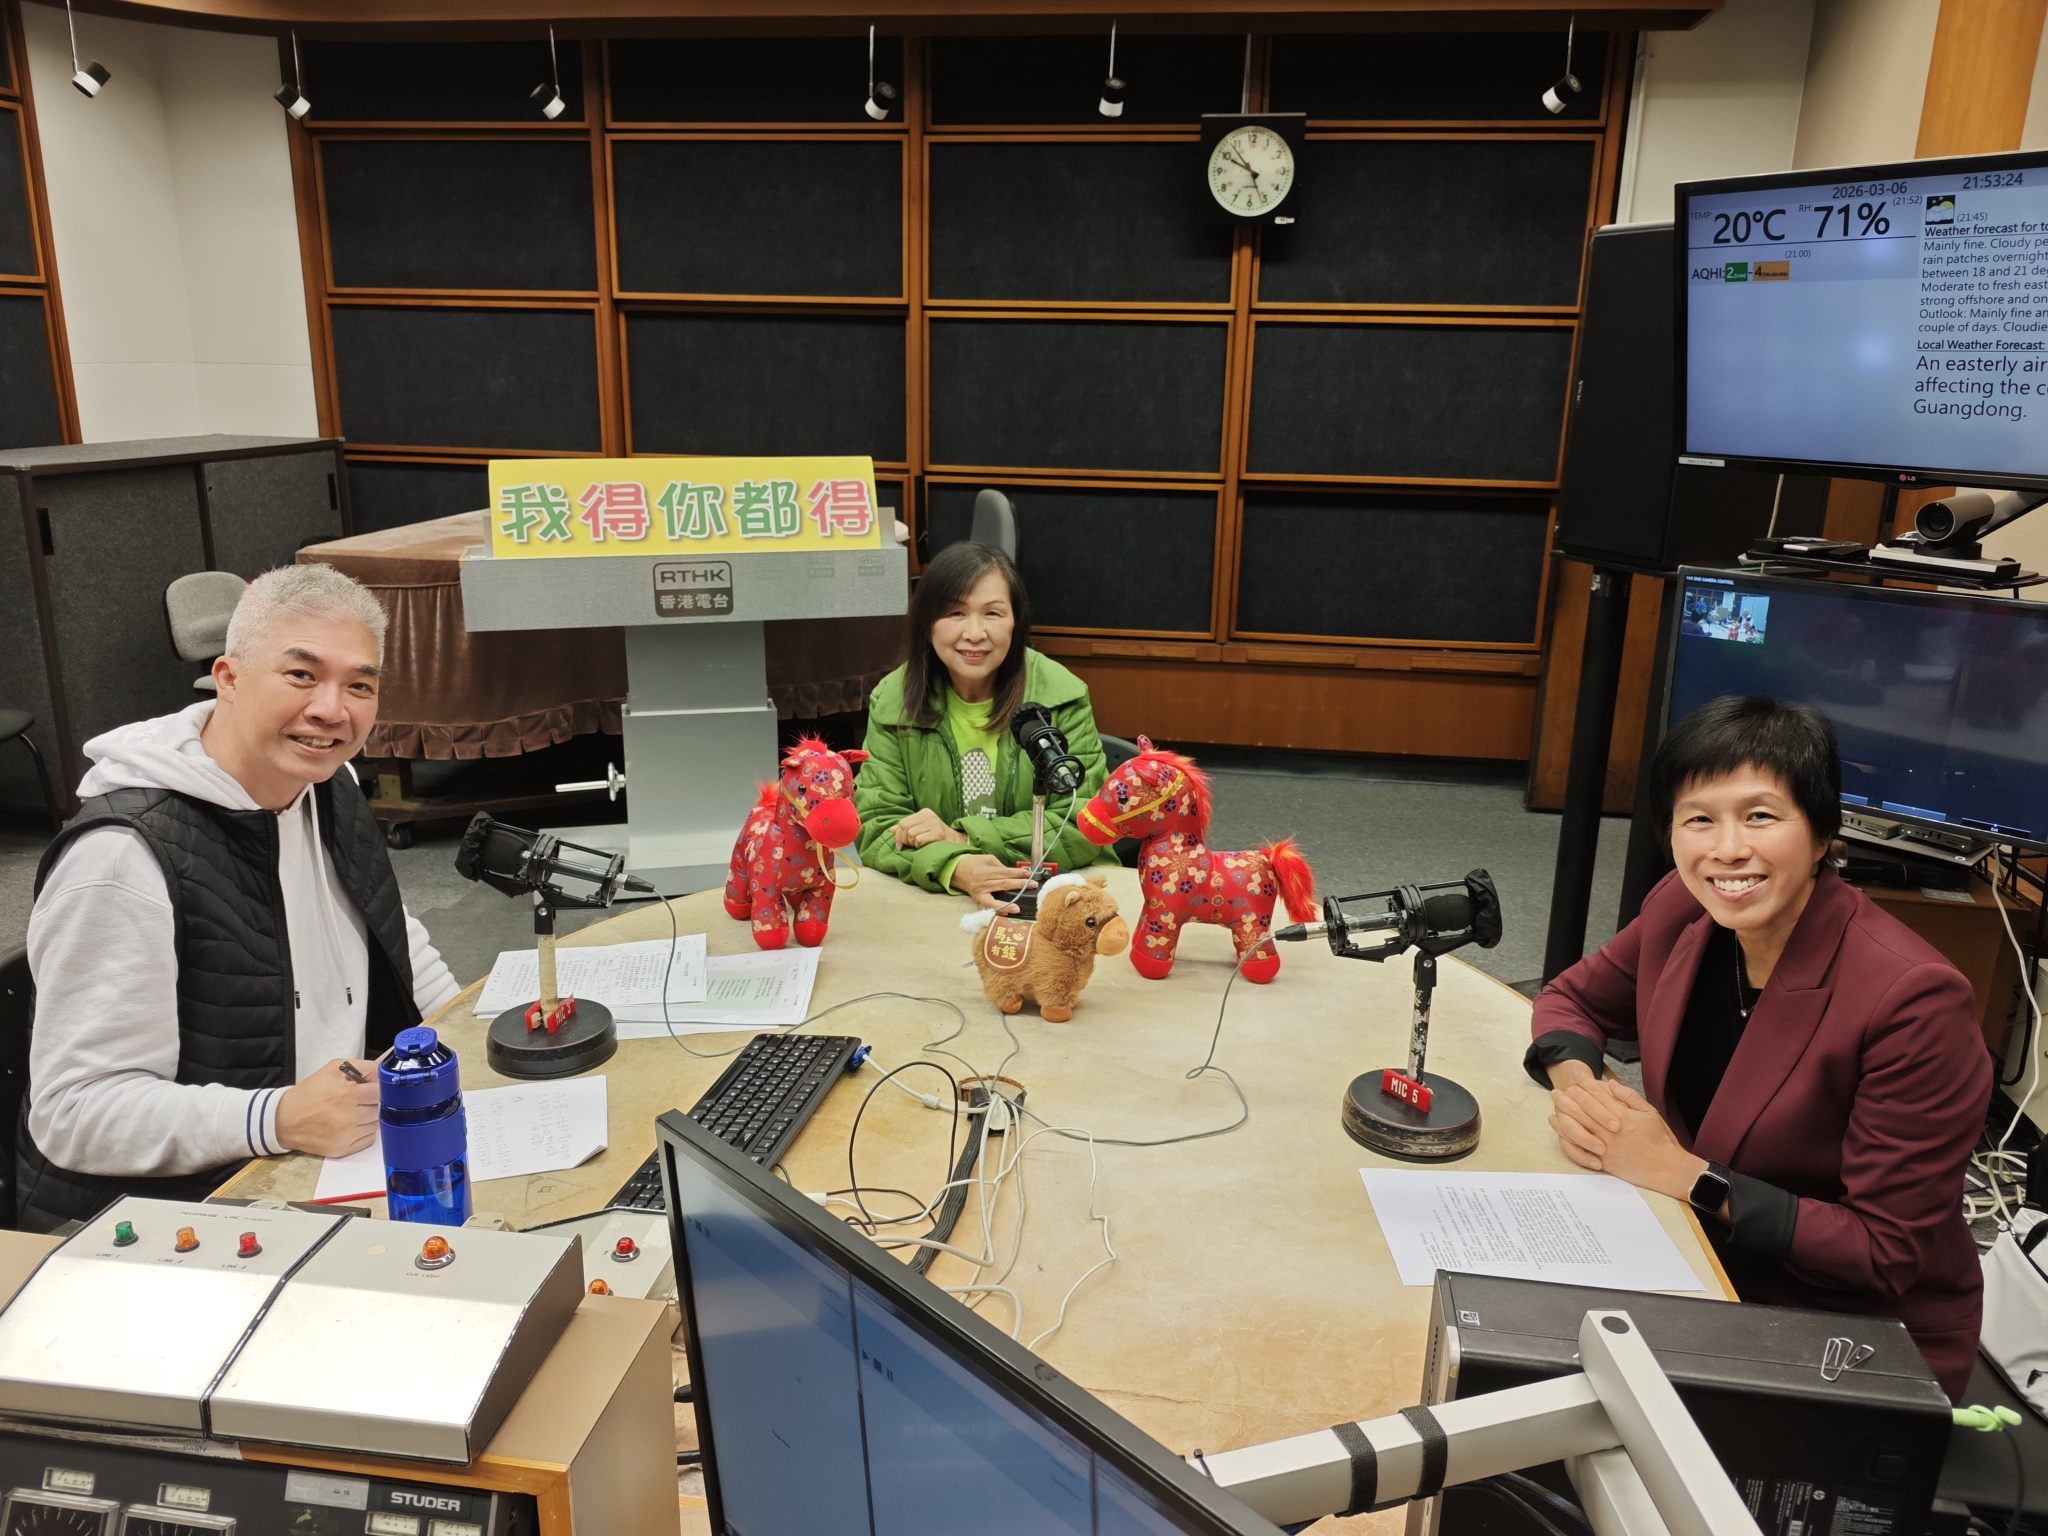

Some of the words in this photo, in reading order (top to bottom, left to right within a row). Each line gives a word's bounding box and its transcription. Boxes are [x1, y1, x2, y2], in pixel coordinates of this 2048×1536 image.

[1217, 167, 1223, 176] 9
[1280, 167, 1286, 176] 3
[1221, 184, 1227, 192] 8
[1832, 181, 1908, 199] 2026-03-06
[1962, 172, 2024, 190] 21:53:24
[1232, 194, 1238, 203] 7
[1814, 201, 1890, 238] 71%
[1892, 195, 1923, 207] (21:52)
[1957, 212, 1988, 223] (21:45)
[1925, 225, 1971, 237] Weather
[1973, 223, 2018, 234] forecast
[2021, 221, 2038, 232] for
[1924, 240, 1960, 252] Mainly
[1963, 239, 1987, 250] fine.
[1990, 237, 2031, 250] Cloudy
[1923, 255, 1943, 265] rain
[1946, 253, 1990, 266] patches
[1992, 251, 2048, 264] overnight
[1691, 267, 1726, 280] AQHI:
[1754, 266, 1762, 278] 4
[1922, 268, 1969, 279] between
[1972, 266, 1986, 277] 18
[1989, 266, 2011, 277] and
[2013, 265, 2028, 276] 21
[2031, 265, 2048, 277] de
[1921, 281, 1975, 292] Moderate
[1978, 282, 1990, 291] to
[1993, 280, 2021, 291] fresh
[2024, 280, 2048, 290] east
[1920, 296, 1955, 307] strong
[1958, 295, 2005, 305] offshore
[2007, 293, 2030, 304] and
[2033, 296, 2048, 304] on
[1919, 308, 1966, 319] Outlook:
[1970, 308, 2008, 320] Mainly
[2010, 307, 2032, 318] fine
[1918, 322, 1955, 334] couple
[1957, 321, 1969, 332] of
[1971, 322, 2000, 334] days.
[2003, 321, 2048, 332] Cloudie
[1917, 340, 1945, 350] Local
[1947, 339, 1993, 350] Weather
[1996, 339, 2046, 350] Forecast:
[1916, 355, 1940, 371] An
[1946, 355, 2018, 377] easterly
[2023, 356, 2048, 372] air
[1914, 376, 1994, 399] affecting
[2000, 378, 2031, 395] the
[2036, 383, 2048, 396] c
[1913, 399, 2027, 422] Guangdong.
[499, 479, 874, 543] 我得你都得
[660, 568, 726, 583] RTHK
[660, 593, 729, 610] 香港電台
[1391, 1077, 1408, 1098] MIC
[391, 1491, 461, 1512] STUDER
